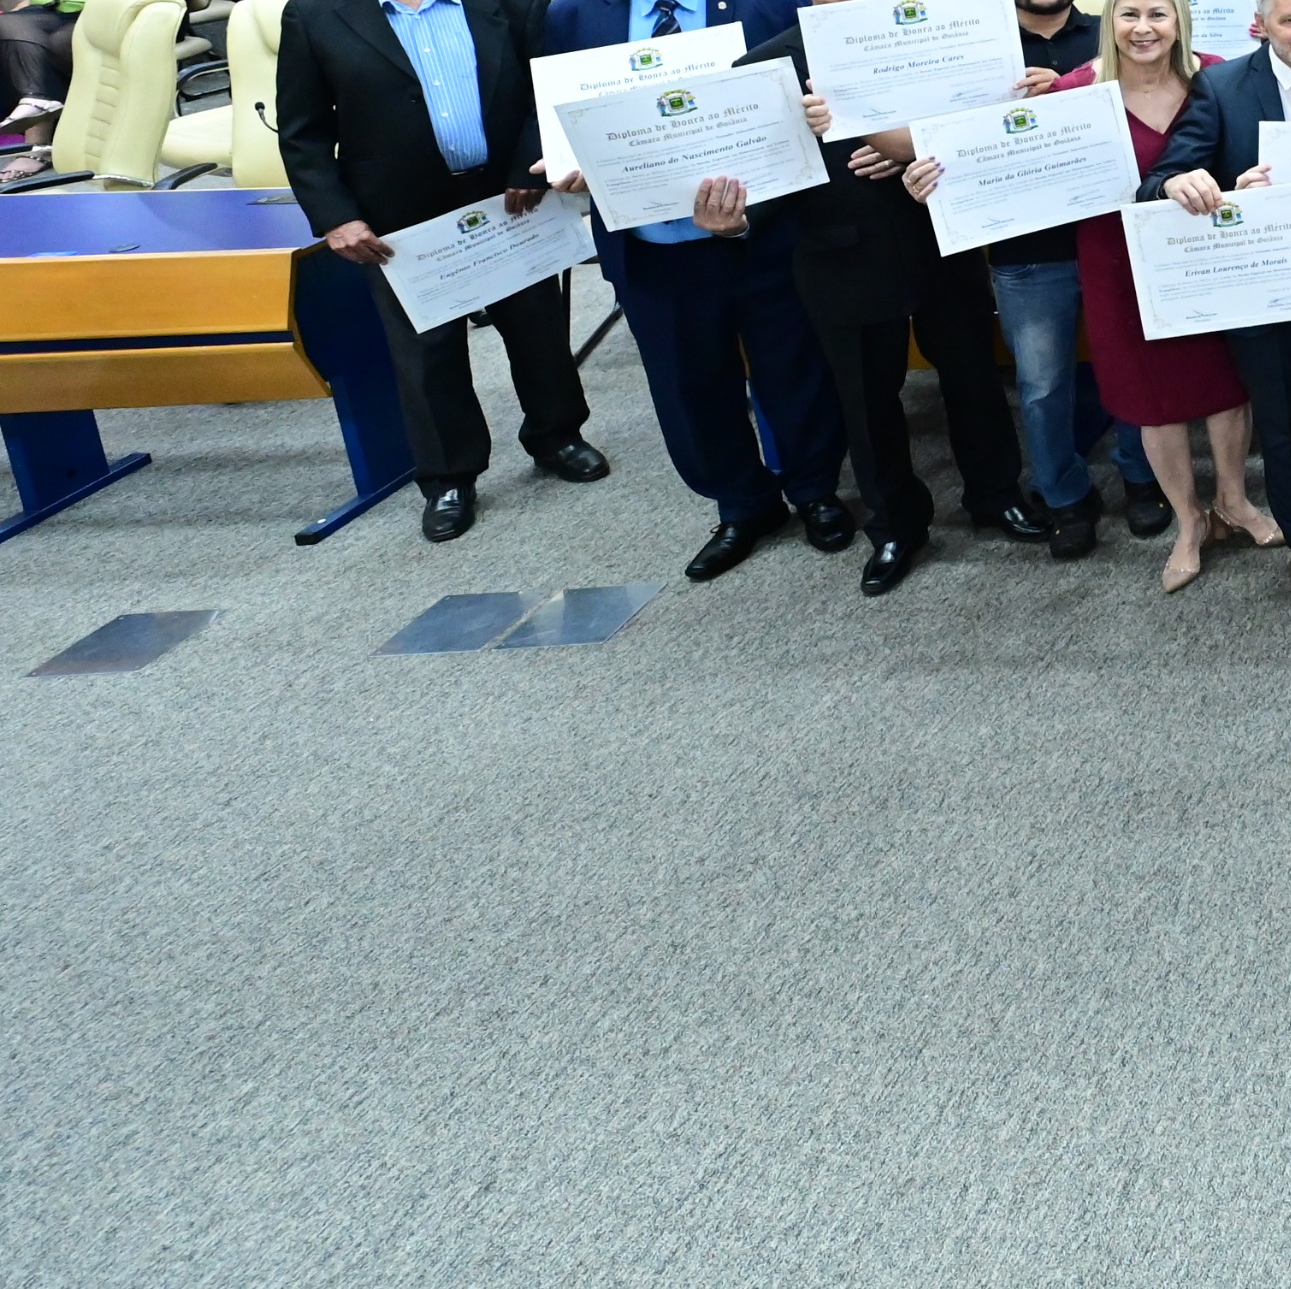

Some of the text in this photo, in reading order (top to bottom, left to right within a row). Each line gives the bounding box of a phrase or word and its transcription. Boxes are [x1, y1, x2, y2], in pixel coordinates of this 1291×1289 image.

[844, 34, 886, 46] Diploma
[902, 26, 932, 36] Honra
[949, 18, 980, 30] Mérito
[580, 60, 716, 92] Diploma de Honra ao Mérito
[873, 64, 904, 76] Rodrigo
[908, 58, 940, 68] Moreira
[605, 102, 758, 142] Diploma de Honra ao Mérito
[628, 135, 660, 148] Câmara
[663, 126, 703, 142] Municipal
[716, 116, 748, 128] Goiânia
[622, 135, 768, 174] Aureliano do Nascimento Galvão
[957, 122, 1092, 158] Diploma de Honra ao Mérito
[976, 152, 1004, 164] Câmara
[1007, 144, 1042, 157] Municipal
[1054, 135, 1081, 146] Goiânia
[978, 156, 1087, 187] Maria da Glória Guimarães
[417, 243, 456, 261] Diploma
[458, 236, 466, 246] de
[470, 226, 498, 240] Honra
[499, 220, 508, 229] ao
[1167, 234, 1205, 246] Diploma
[1208, 232, 1216, 240] de
[1220, 229, 1248, 239] Honra
[1185, 266, 1211, 277] Erivan
[1212, 262, 1249, 274] Lourenço
[1261, 257, 1288, 267] Morais
